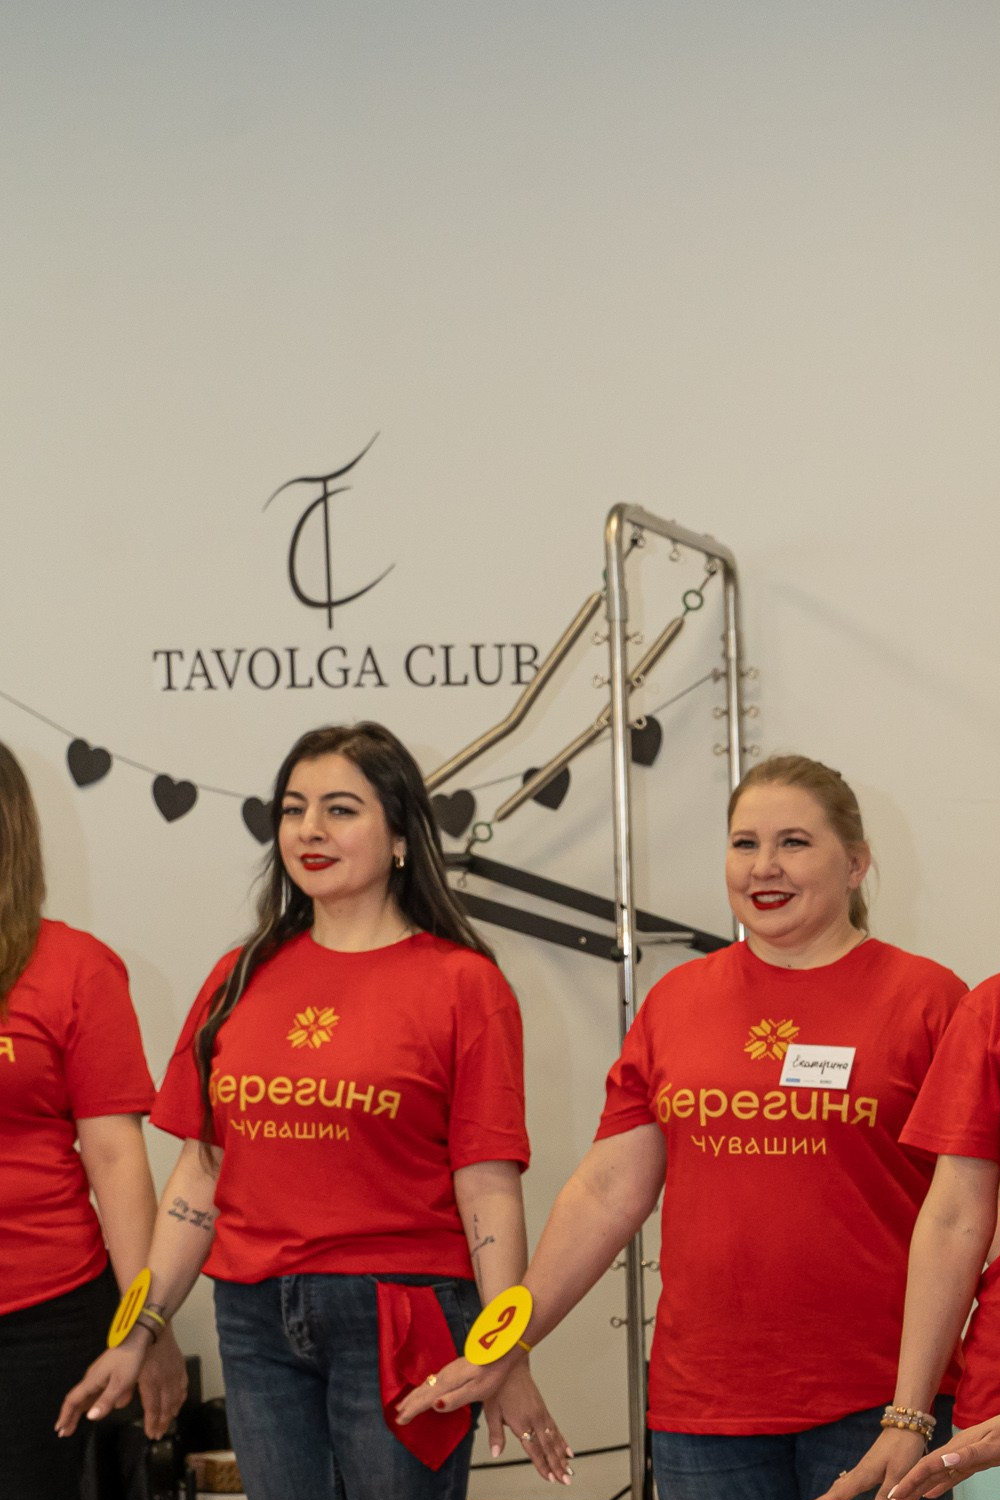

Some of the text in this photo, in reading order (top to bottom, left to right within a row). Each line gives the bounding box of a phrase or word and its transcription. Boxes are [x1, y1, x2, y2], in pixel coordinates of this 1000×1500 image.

[153, 643, 541, 692] TAVOLGA CLUB
[656, 1082, 879, 1128] берегиня
[230, 1119, 351, 1141] чувашии
[690, 1134, 828, 1158] чувашии
[478, 1305, 517, 1350] 2
